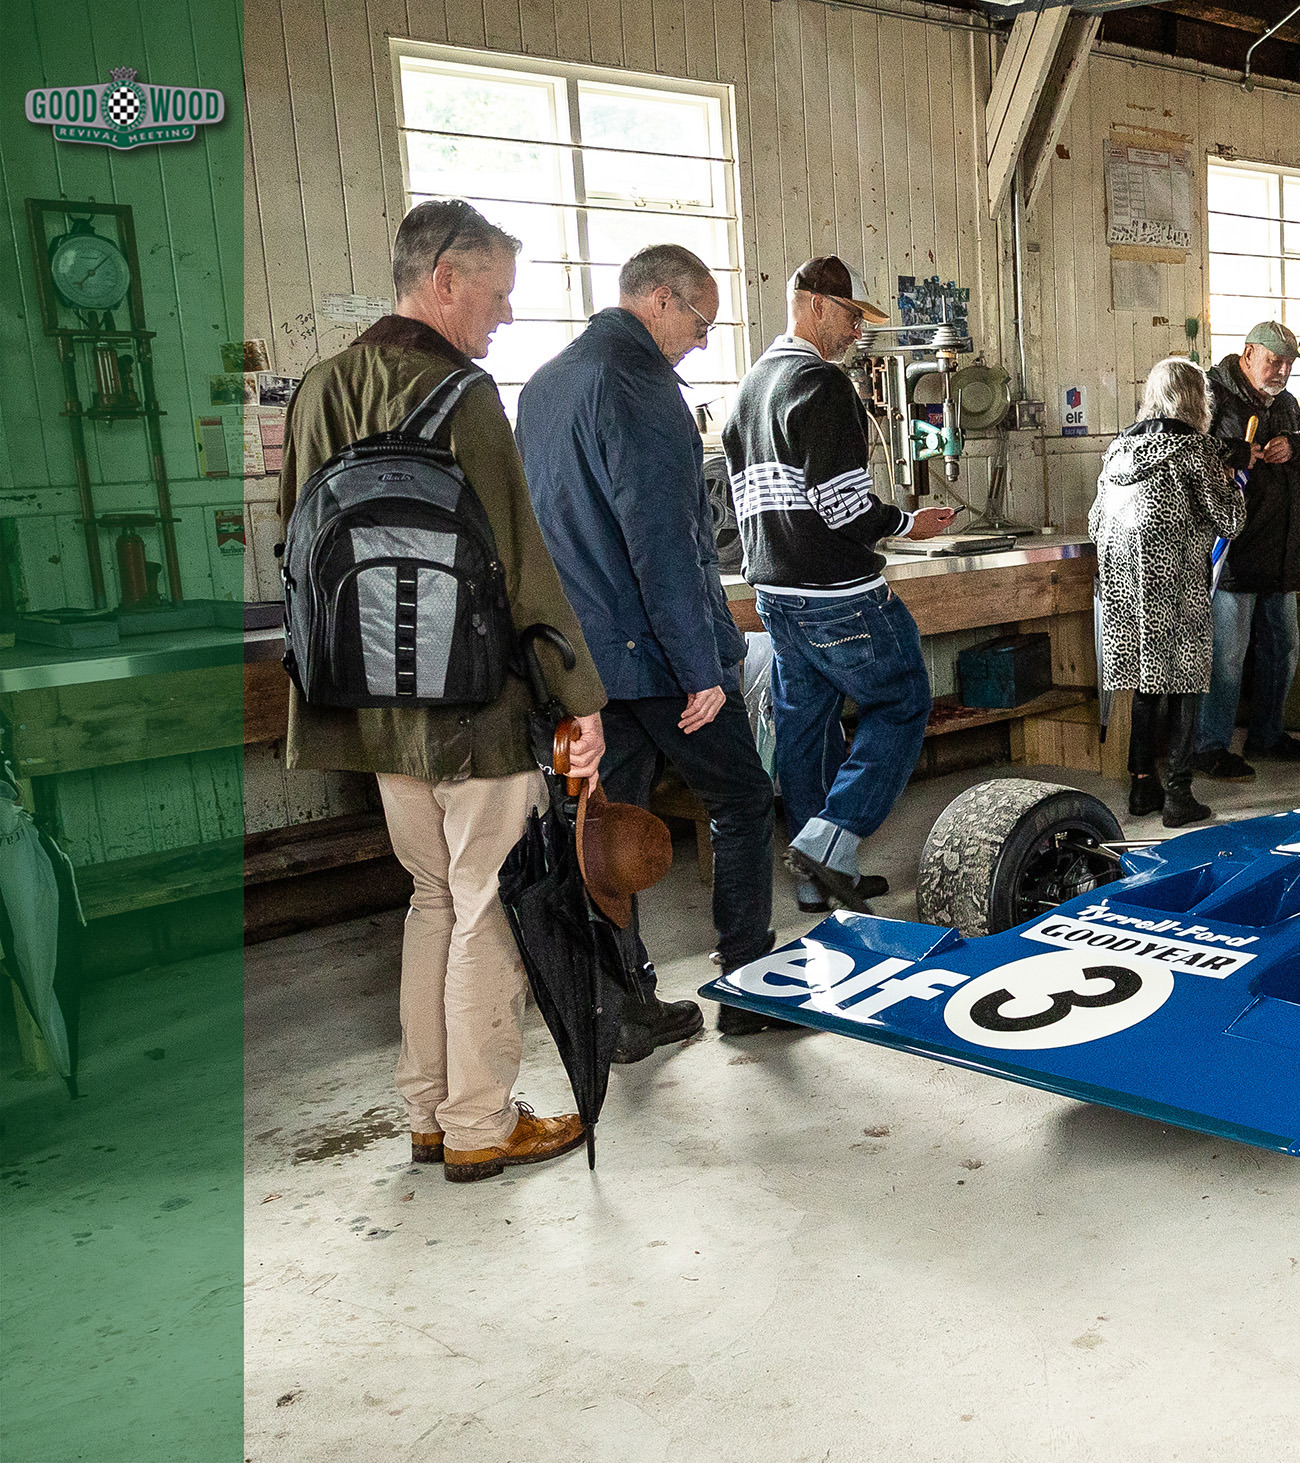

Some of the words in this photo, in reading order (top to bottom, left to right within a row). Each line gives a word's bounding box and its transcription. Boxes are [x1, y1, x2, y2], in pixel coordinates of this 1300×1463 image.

[1065, 411, 1083, 424] elf
[1040, 923, 1238, 971] GOODYEAR
[1076, 898, 1260, 947] Tyrrell-Ford
[733, 947, 971, 1019] elf
[969, 965, 1143, 1032] 3
